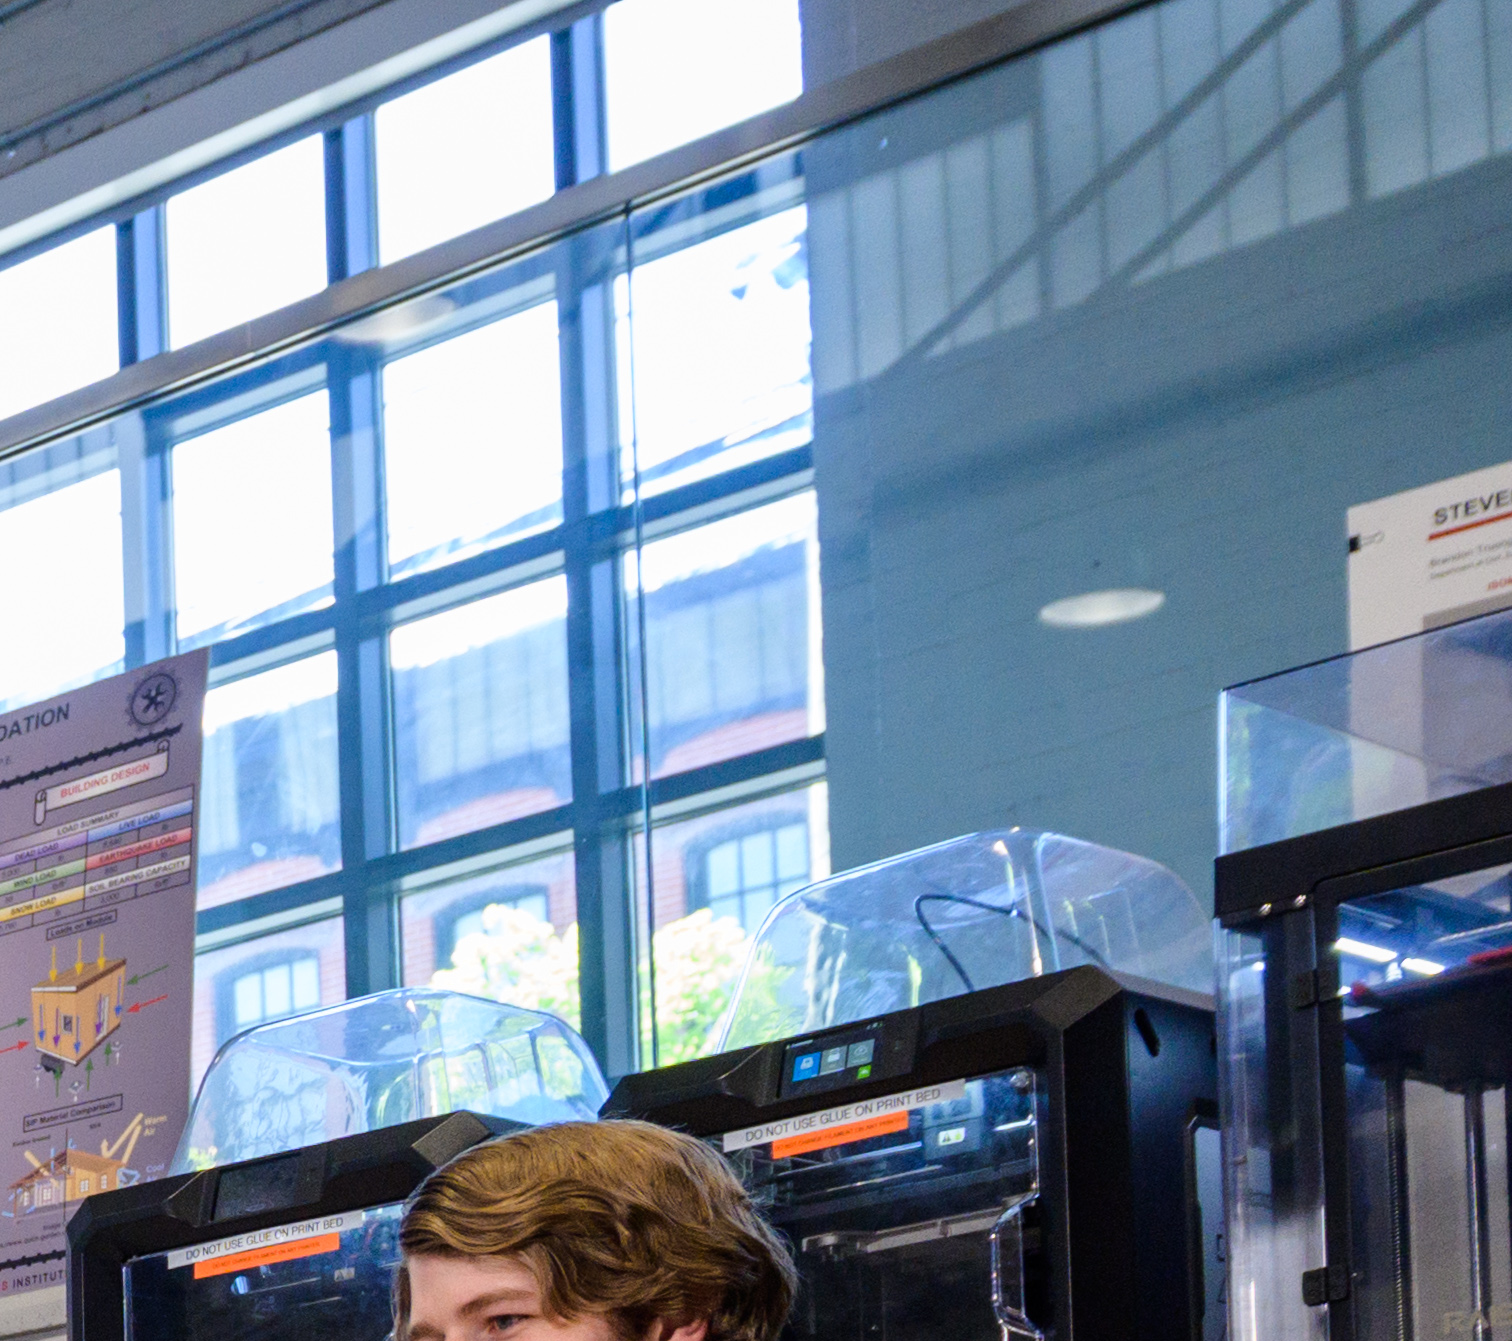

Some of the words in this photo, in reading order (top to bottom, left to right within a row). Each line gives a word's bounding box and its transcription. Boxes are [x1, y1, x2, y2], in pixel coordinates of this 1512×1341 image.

[1434, 489, 1512, 525] STEVE
[60, 774, 108, 798] BUILDING
[110, 761, 150, 783] DESIGN
[56, 822, 79, 836] LOAD
[80, 810, 120, 829] SUMMARY
[118, 818, 136, 831] LIVE
[137, 811, 160, 825] LOAD
[14, 848, 36, 862] DEAD
[37, 841, 59, 855] LOAD
[98, 840, 153, 864] EARTHQUAKE
[154, 833, 178, 848] LOAD
[13, 875, 33, 889] WIND
[34, 868, 57, 883] LOAD
[88, 881, 106, 894] SOIL
[107, 870, 143, 889] BEARING
[145, 858, 186, 878] CAPACITY
[10, 901, 35, 916] SNOW
[35, 895, 56, 909] LOAD
[25, 1117, 38, 1128] SIP
[39, 1110, 68, 1125] Material
[70, 1099, 116, 1118] Comparison
[143, 1112, 167, 1127] Warm
[745, 1129, 763, 1143] DO
[766, 1123, 790, 1139] NOT
[793, 1115, 817, 1132] USE
[820, 1107, 852, 1125] GLUE
[854, 1102, 873, 1118] ON
[876, 1094, 912, 1113] PRINT
[915, 1087, 941, 1103] BED
[143, 1126, 155, 1137] Air
[145, 1161, 164, 1174] Cool
[185, 1249, 201, 1261] DO
[202, 1244, 222, 1257] NOT
[224, 1238, 244, 1251] USE
[246, 1232, 272, 1246] GLUE
[274, 1227, 289, 1239] ON
[291, 1222, 321, 1237] PRINT
[323, 1217, 344, 1231] BED
[13, 1269, 66, 1290] INSTITUT
